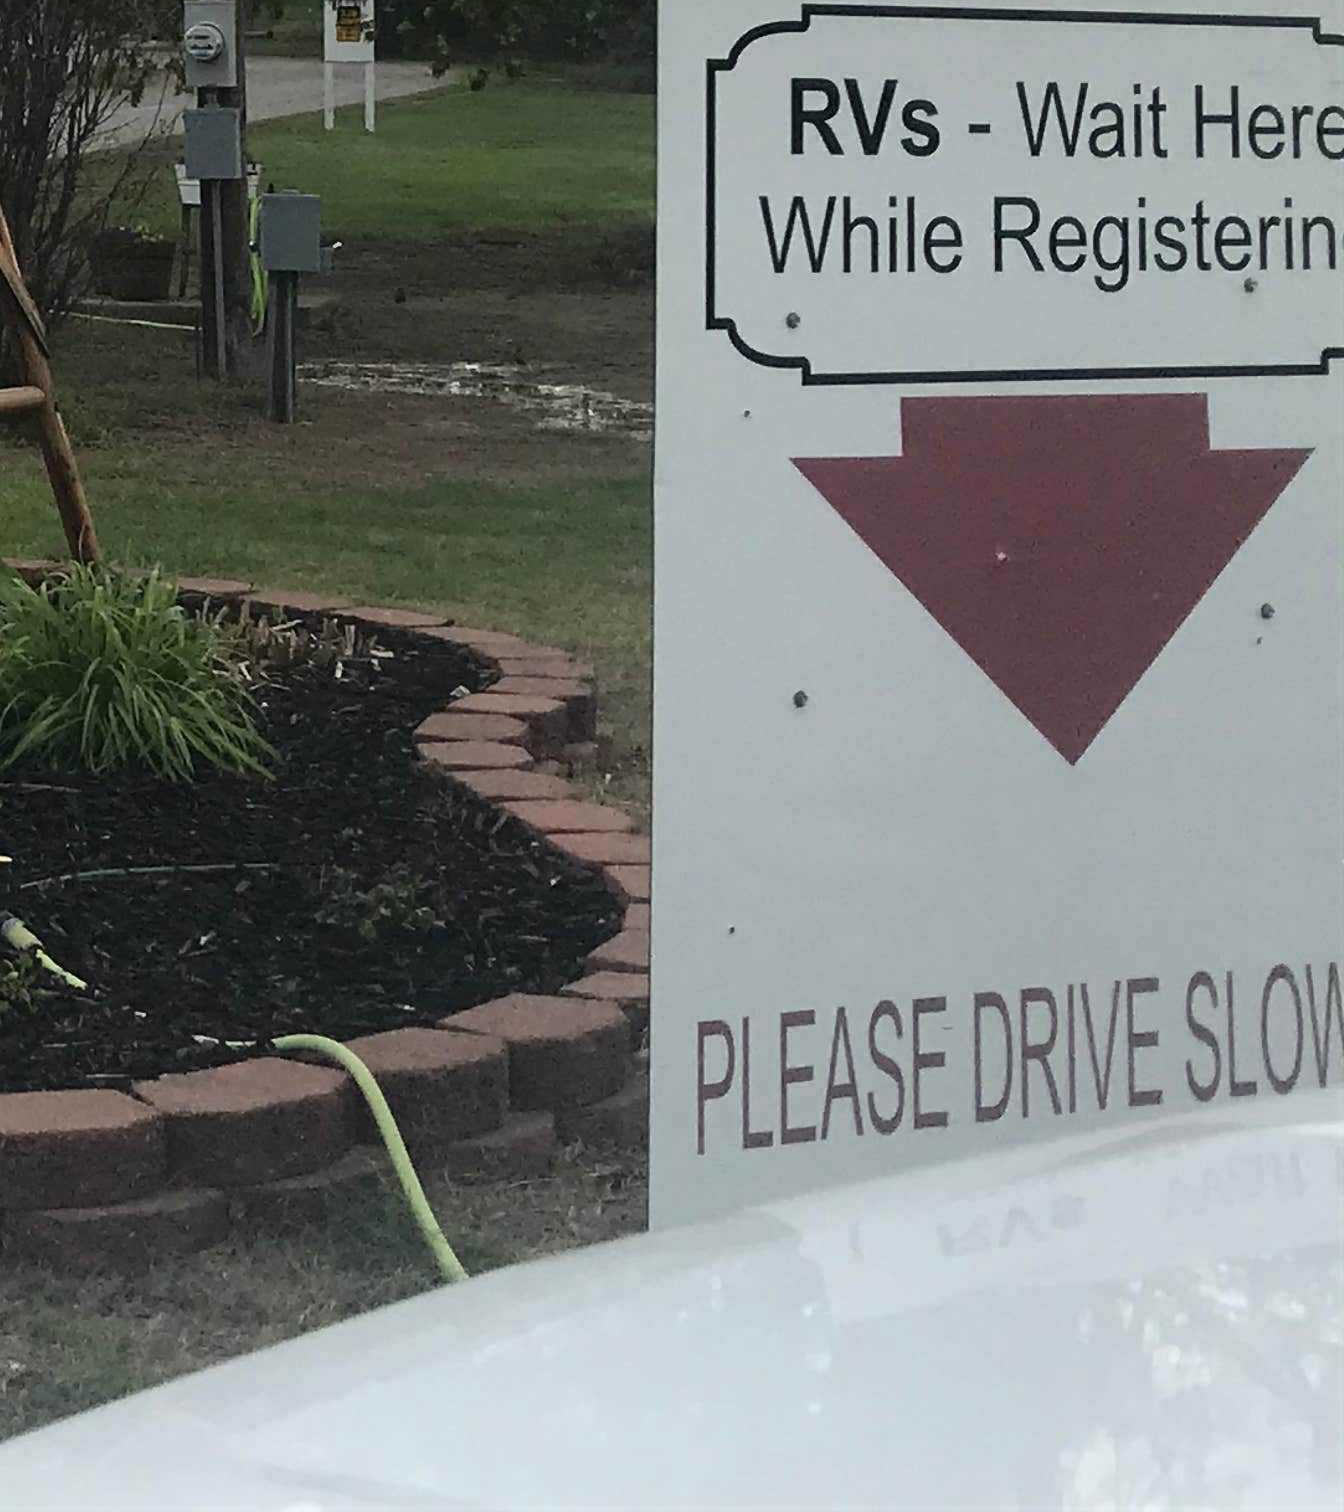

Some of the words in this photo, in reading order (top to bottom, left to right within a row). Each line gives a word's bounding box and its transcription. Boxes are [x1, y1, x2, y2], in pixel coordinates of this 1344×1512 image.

[790, 77, 940, 157] RVs
[1015, 81, 1168, 159] Wait
[1194, 84, 1344, 161] Here
[758, 195, 963, 274] While
[993, 196, 1344, 293] Registerin
[697, 996, 949, 1156] PLEASE
[973, 977, 1164, 1123] DRIVE
[1185, 961, 1344, 1103] SLOW
